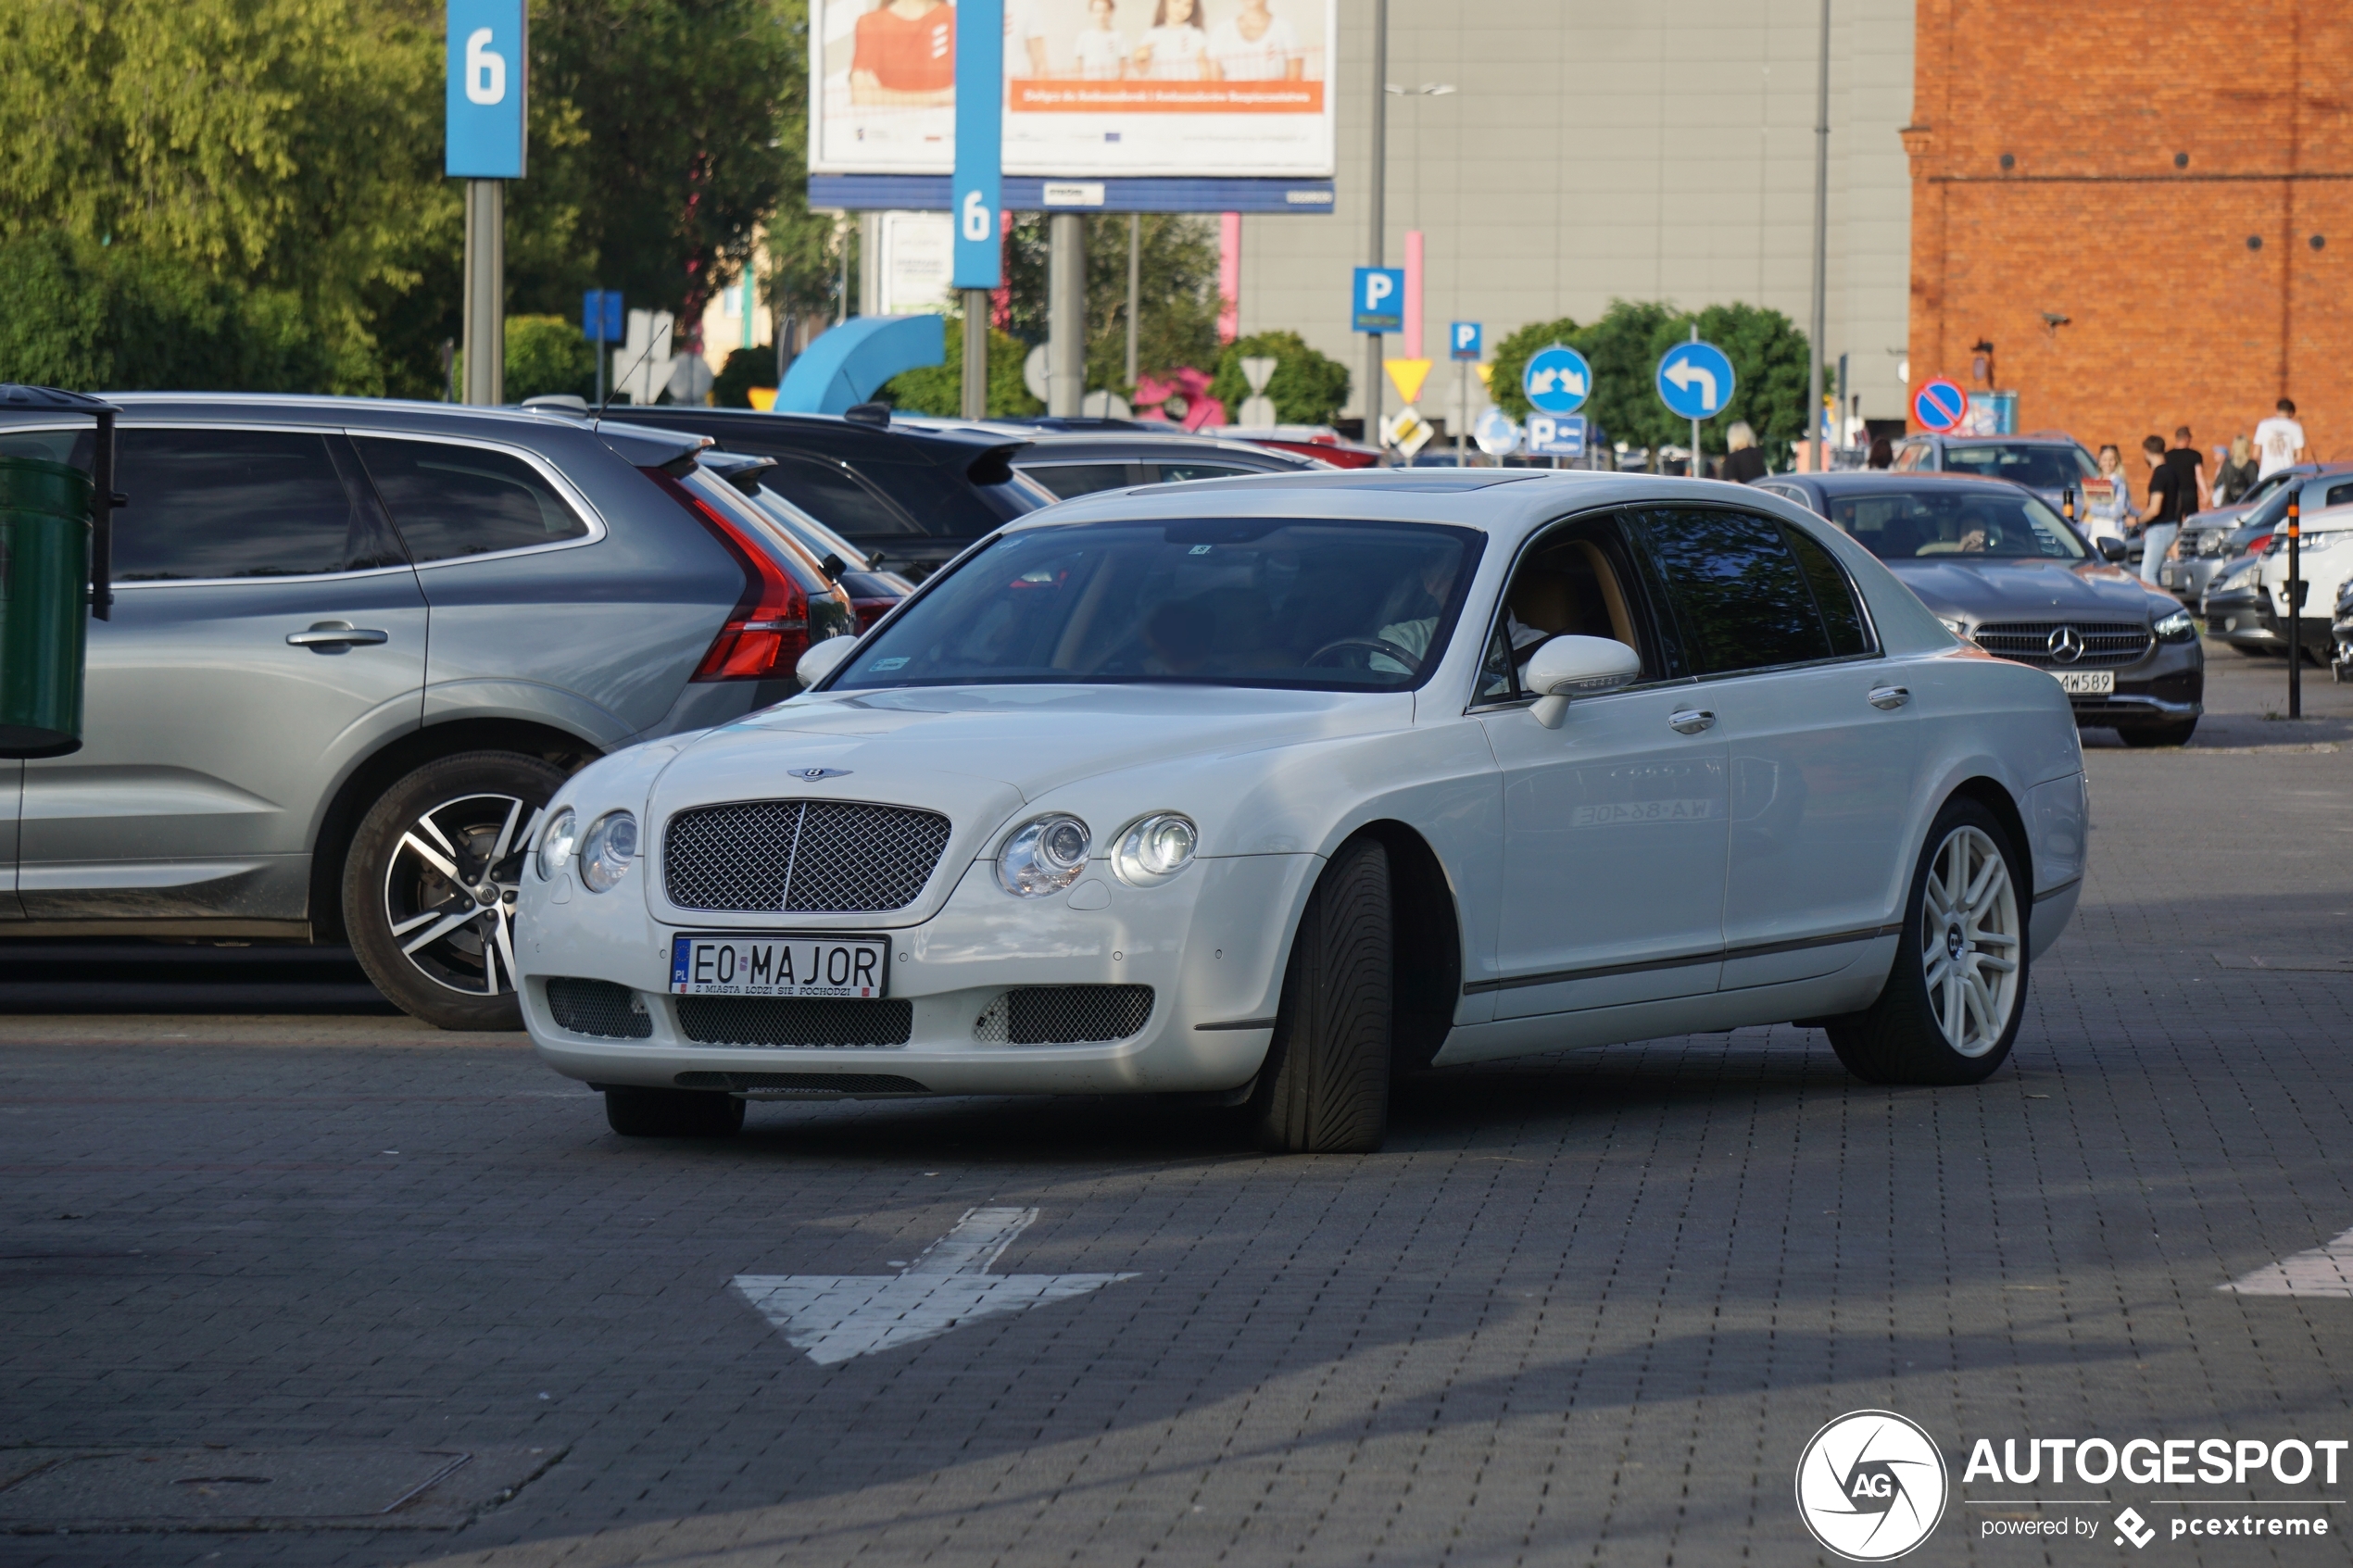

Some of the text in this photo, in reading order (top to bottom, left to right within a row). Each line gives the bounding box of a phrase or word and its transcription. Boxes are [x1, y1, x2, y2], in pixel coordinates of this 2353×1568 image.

[465, 27, 506, 105] 6
[963, 189, 990, 242] 6
[1365, 272, 1393, 310] P
[1457, 325, 1476, 349] P
[1531, 418, 1556, 451] P
[674, 970, 686, 981] PL
[750, 945, 877, 987] MAJOR
[705, 985, 740, 994] MIASTA
[799, 987, 850, 997] POCHODZI
